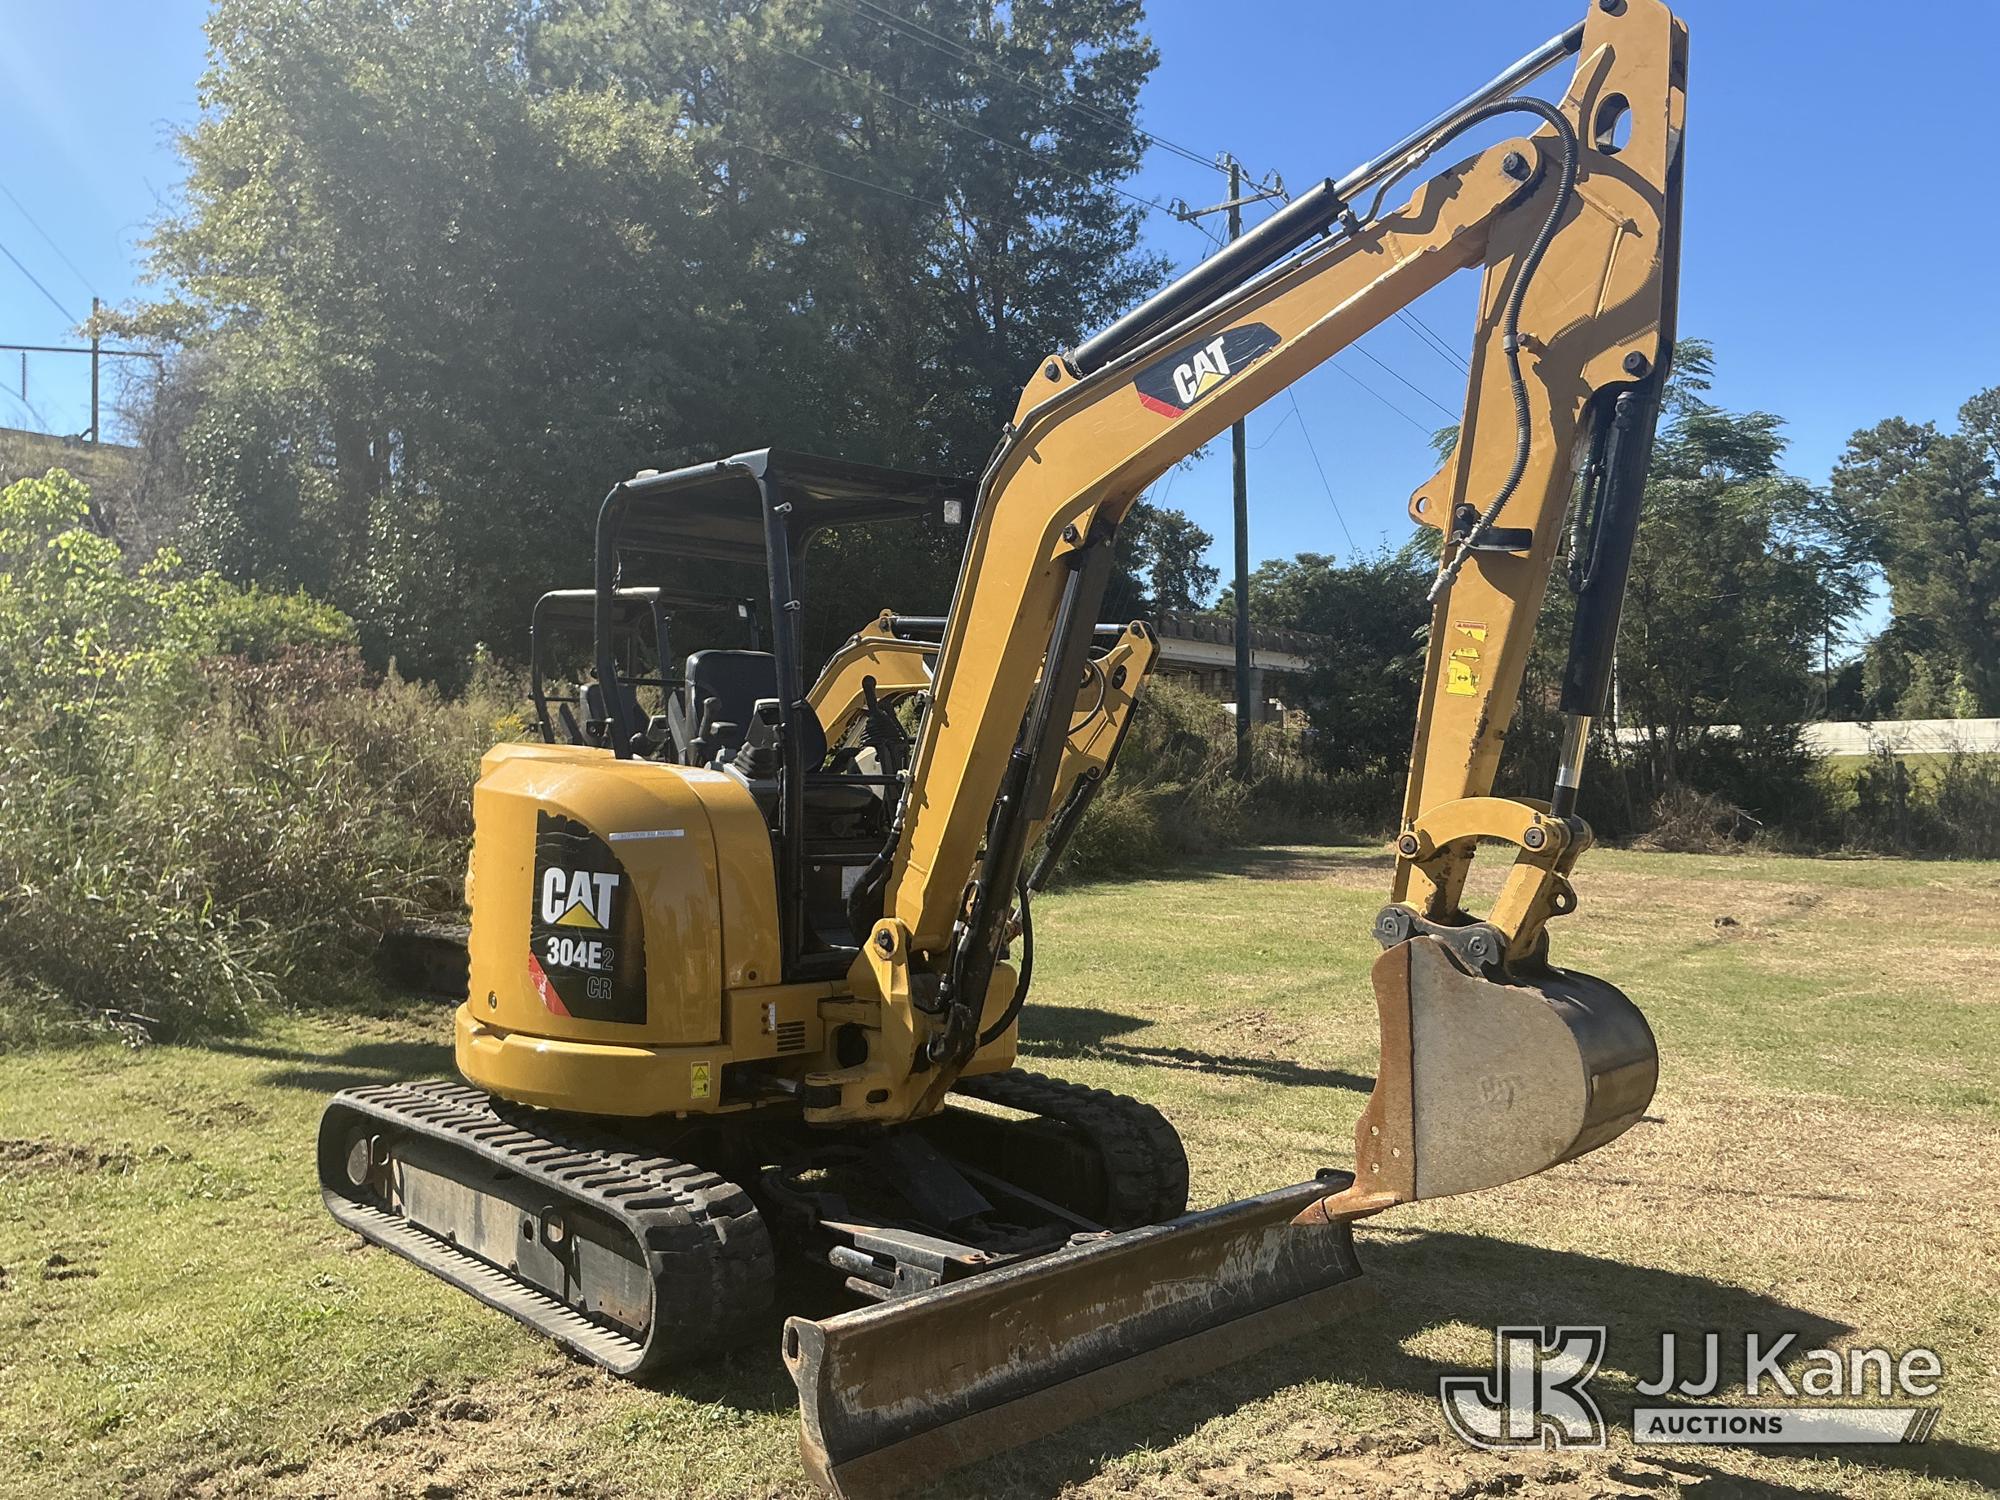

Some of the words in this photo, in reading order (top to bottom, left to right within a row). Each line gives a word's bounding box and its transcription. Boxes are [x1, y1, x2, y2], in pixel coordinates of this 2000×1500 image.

[1172, 336, 1230, 403] CAT
[542, 867, 619, 929] CAT
[546, 936, 615, 971] 304E2
[587, 976, 612, 999] CR
